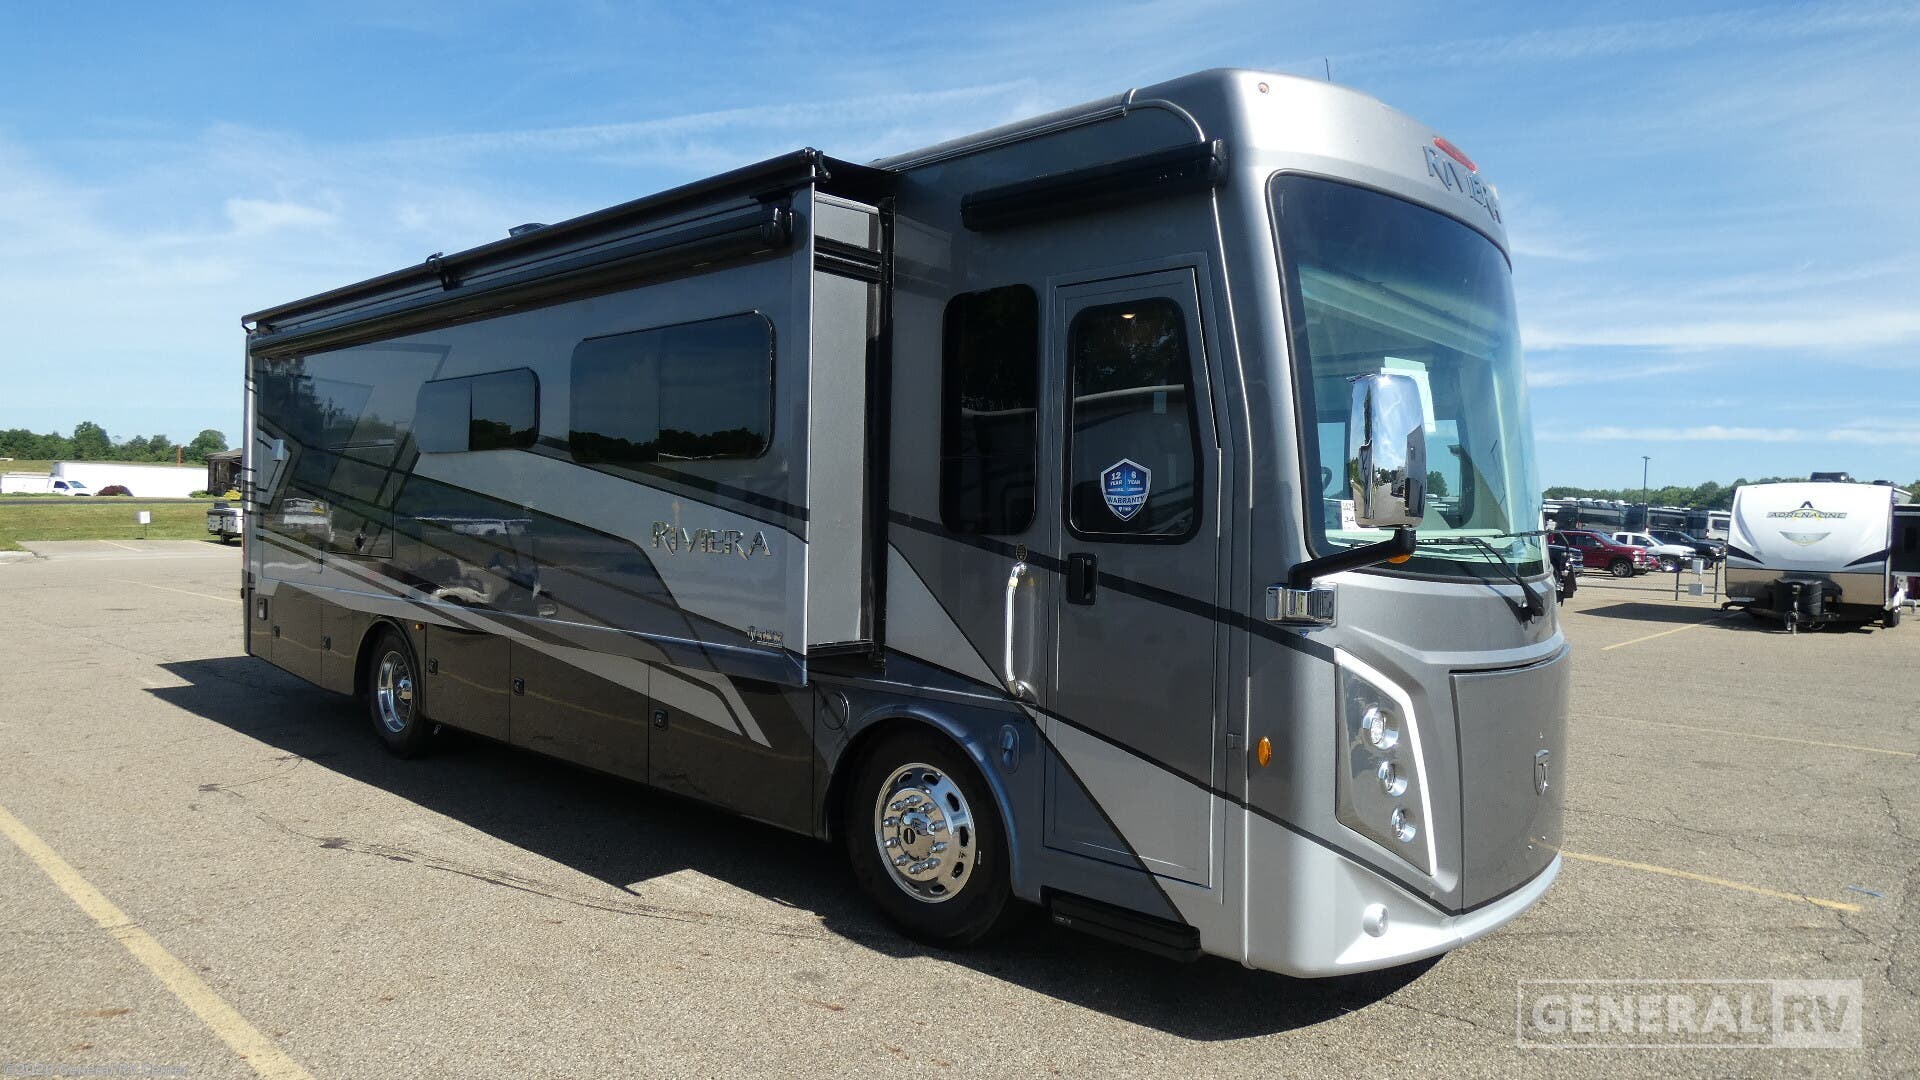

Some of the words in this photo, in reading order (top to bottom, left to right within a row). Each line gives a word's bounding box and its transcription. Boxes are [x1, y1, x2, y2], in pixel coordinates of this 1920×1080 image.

[1111, 471, 1122, 480] 12
[1107, 496, 1144, 504] WARRANTY
[652, 521, 772, 560] RIVIERA
